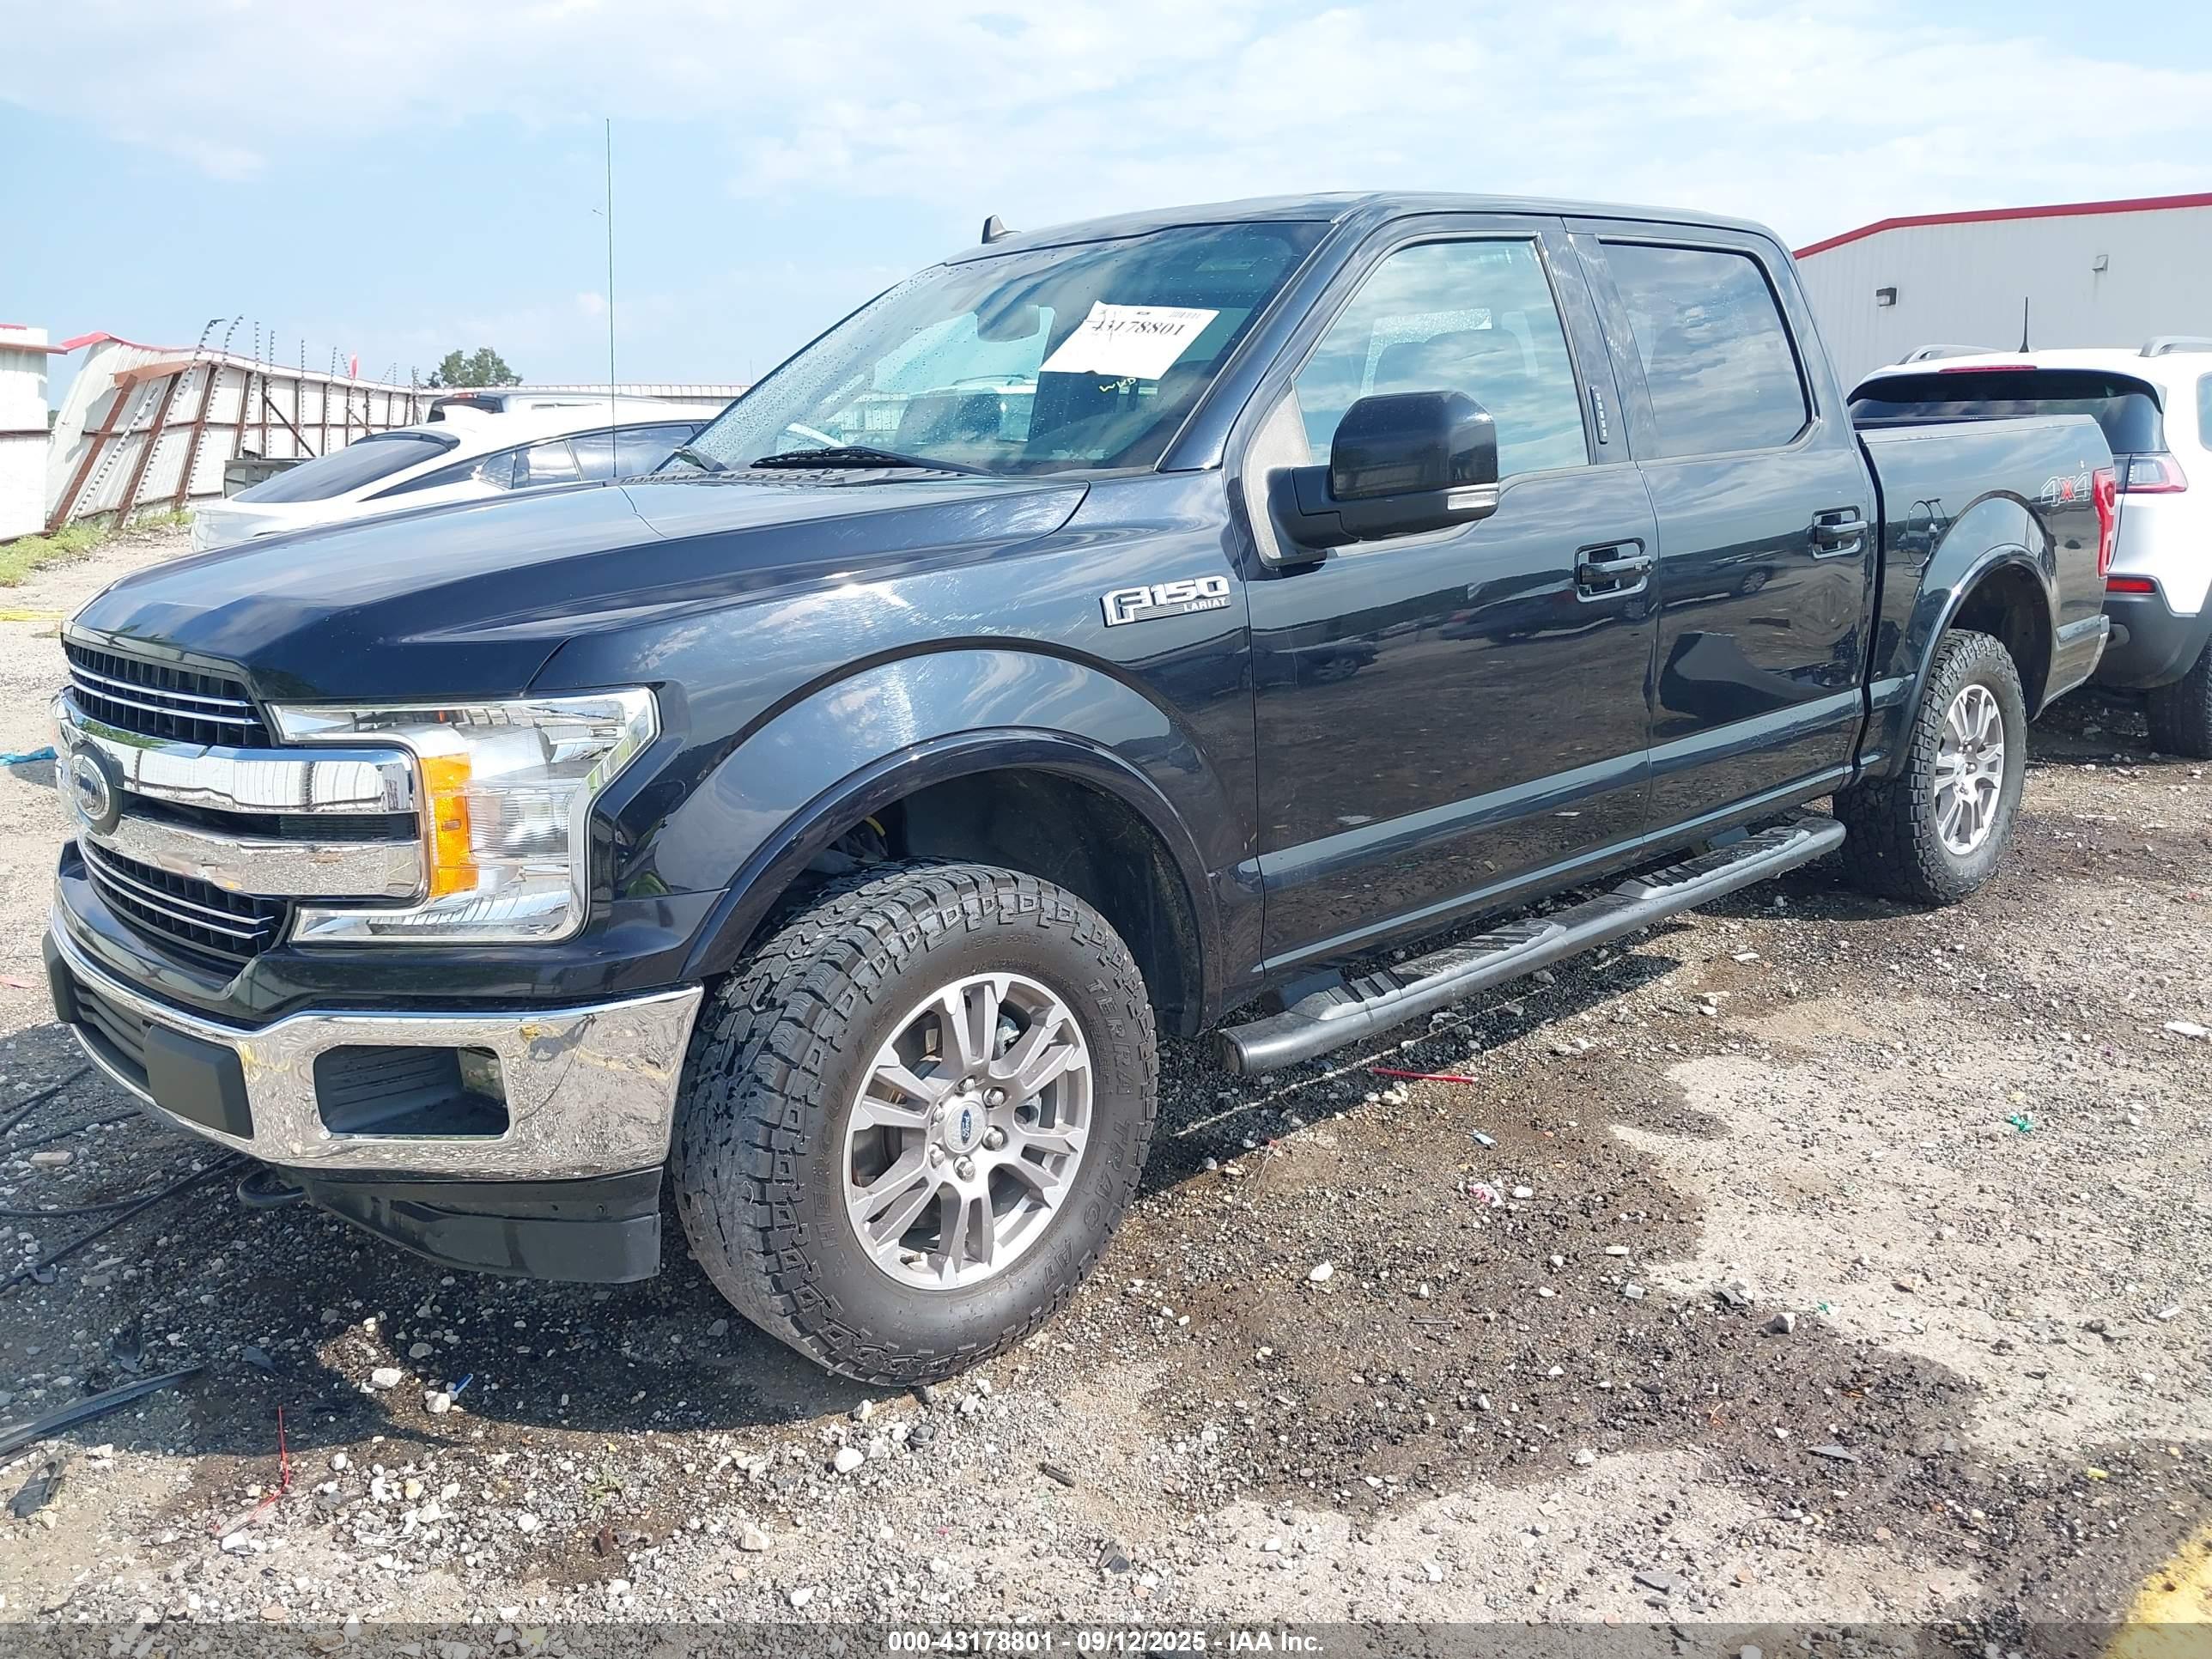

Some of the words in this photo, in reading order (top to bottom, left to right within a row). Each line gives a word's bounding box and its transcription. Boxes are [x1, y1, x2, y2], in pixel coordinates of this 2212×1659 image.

[1182, 598, 1227, 612] LARIAT
[1085, 976, 1134, 1095] TERRA
[1083, 1119, 1133, 1231] TRAC
